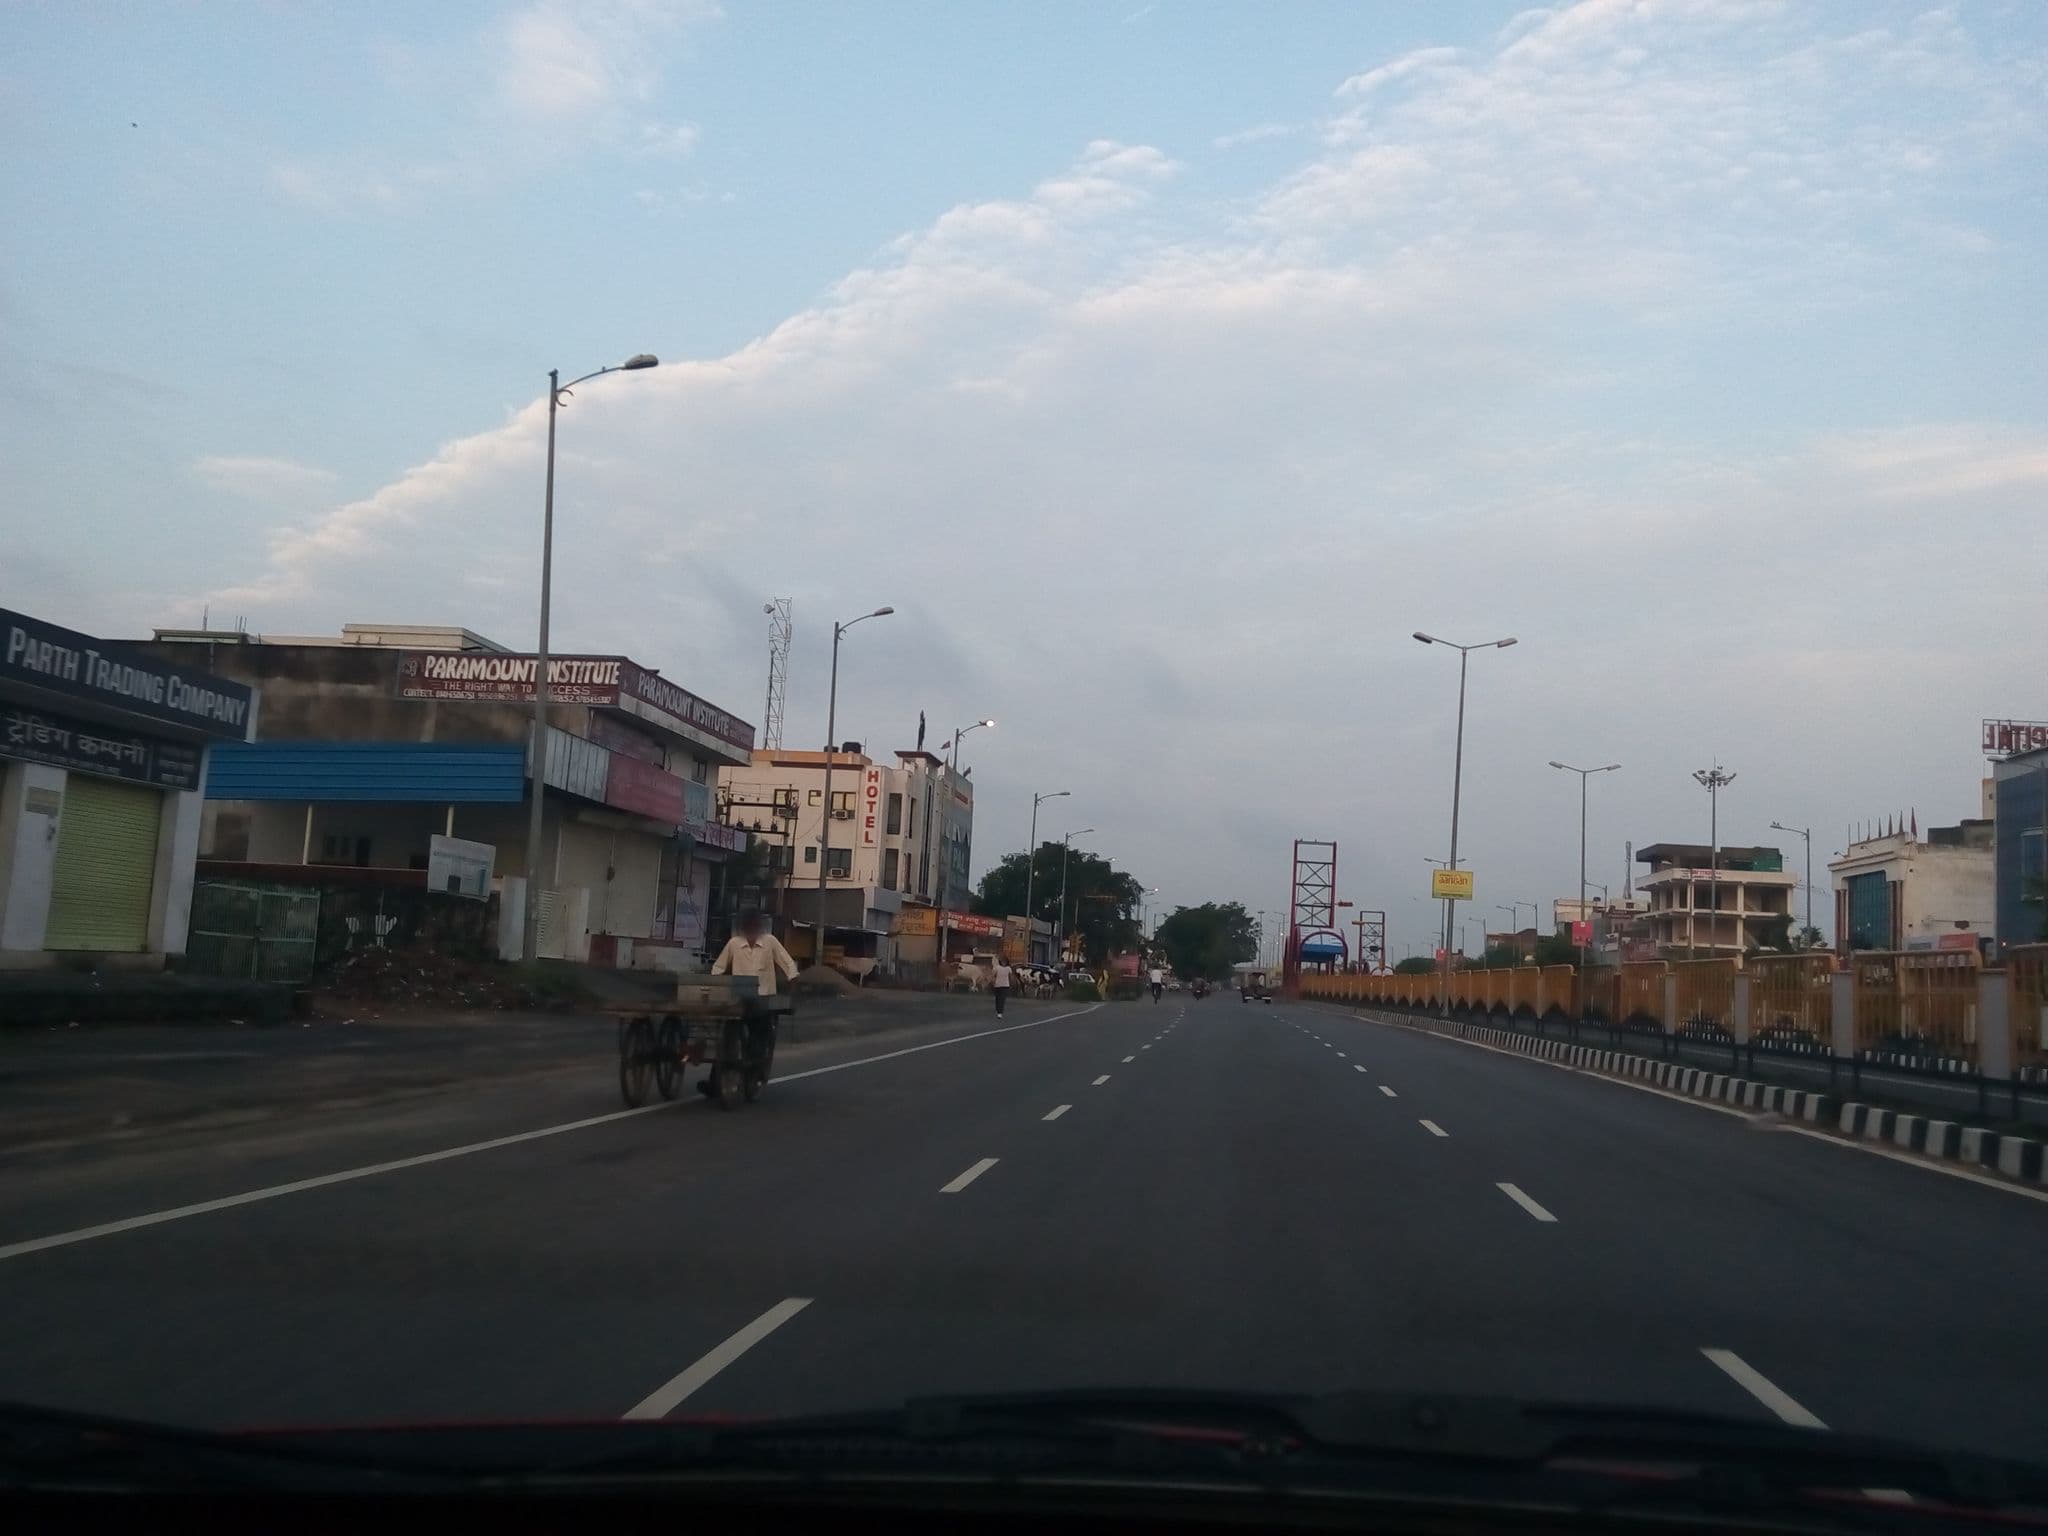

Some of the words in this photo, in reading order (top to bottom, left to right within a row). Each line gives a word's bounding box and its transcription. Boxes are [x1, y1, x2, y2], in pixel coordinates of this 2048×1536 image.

[7, 626, 80, 681] PARTH
[85, 649, 164, 704] TRADING
[167, 674, 247, 726] COMPANY
[424, 655, 538, 682] PARAMOUNT
[546, 661, 621, 685] NSTITUTE
[443, 681, 463, 690] THE
[465, 682, 494, 692] RIGHT
[497, 683, 516, 693] WAY
[521, 684, 532, 694] TO
[638, 672, 693, 718] PARAMOUNT
[692, 698, 730, 737] INSTITUTE
[864, 769, 880, 844] HOTEL
